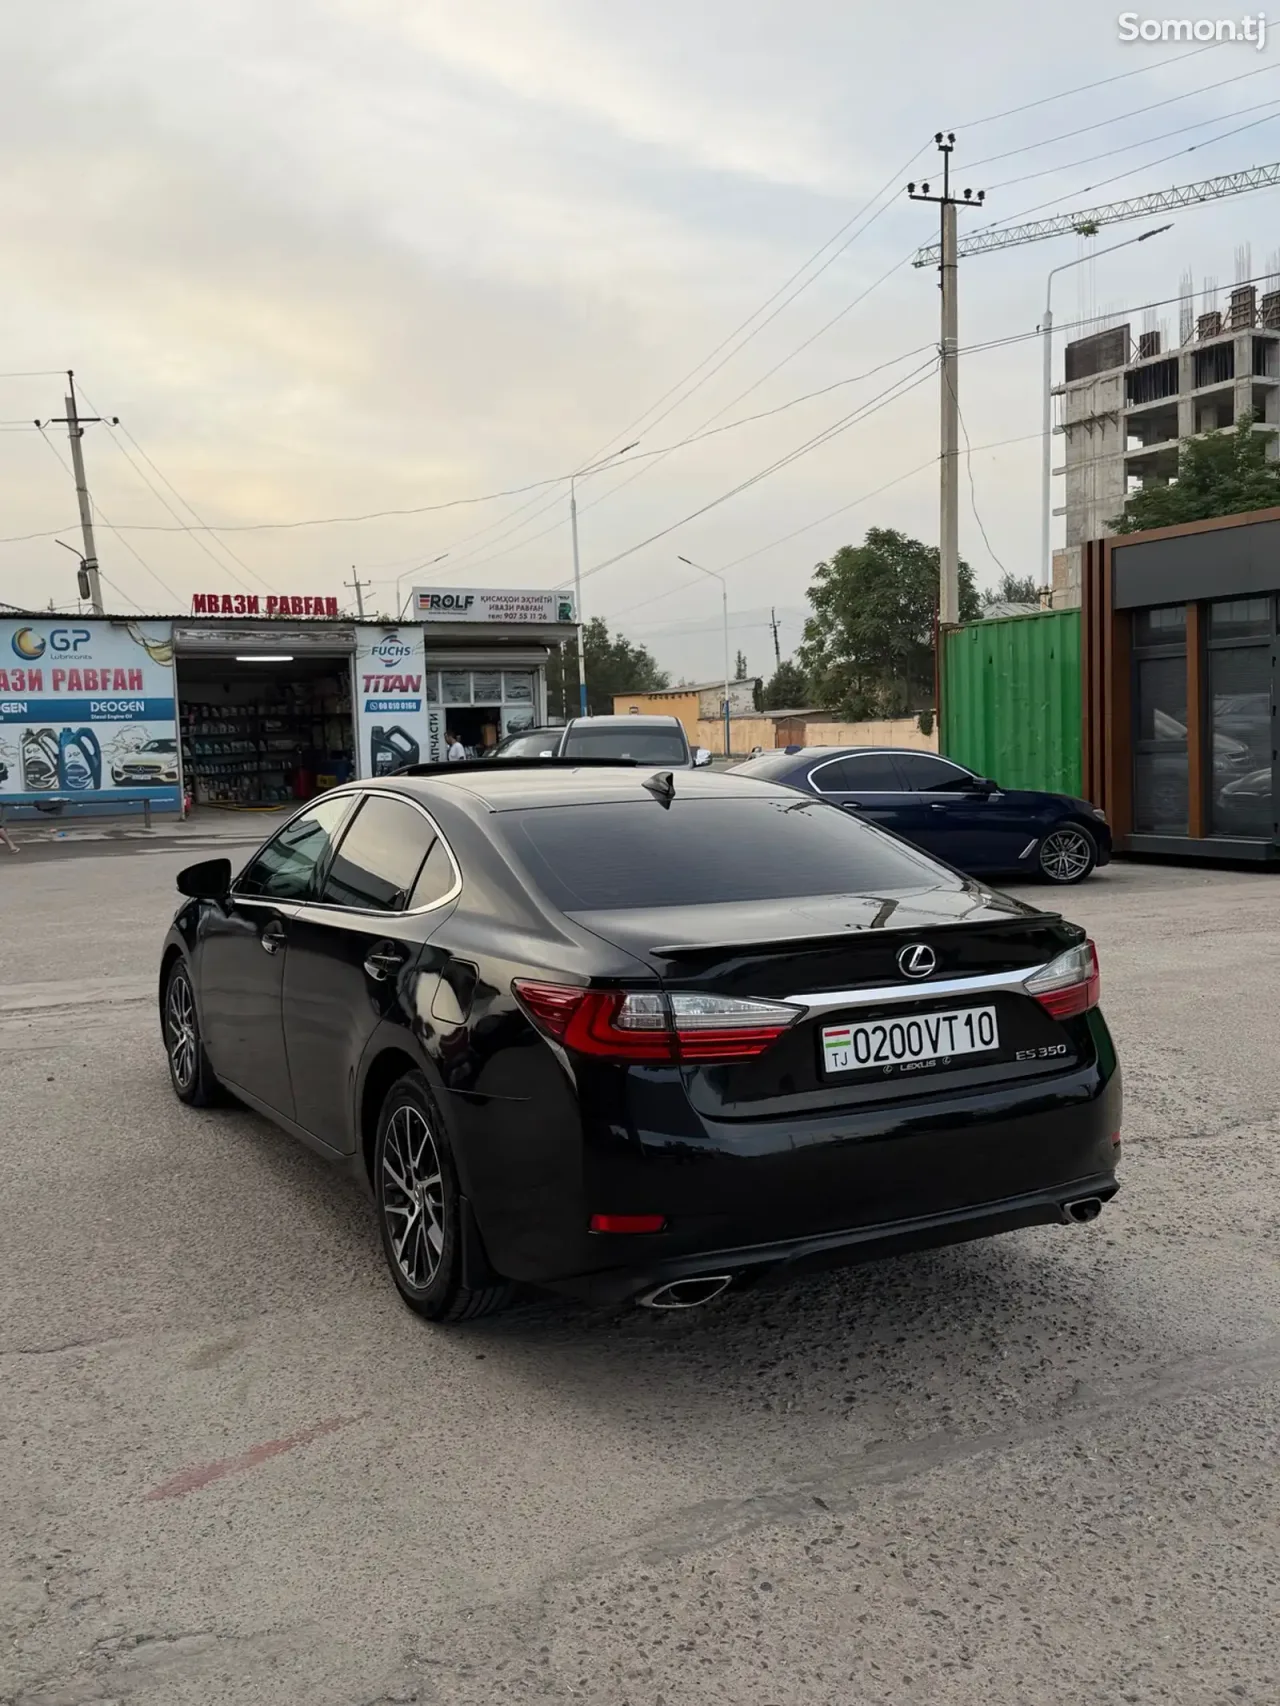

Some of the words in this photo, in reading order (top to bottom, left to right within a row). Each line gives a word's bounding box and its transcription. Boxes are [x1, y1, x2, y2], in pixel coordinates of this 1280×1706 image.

[193, 594, 260, 614] ИВАЗИ
[430, 594, 474, 609] ROLF
[504, 612, 517, 620] 907
[50, 629, 91, 651] GP
[371, 646, 411, 656] FUCHS
[90, 701, 145, 712] DEOGEN
[832, 1052, 849, 1068] TJ
[1015, 1048, 1037, 1061] ES
[1038, 1044, 1067, 1058] 350
[900, 1059, 937, 1072] LEXUS
